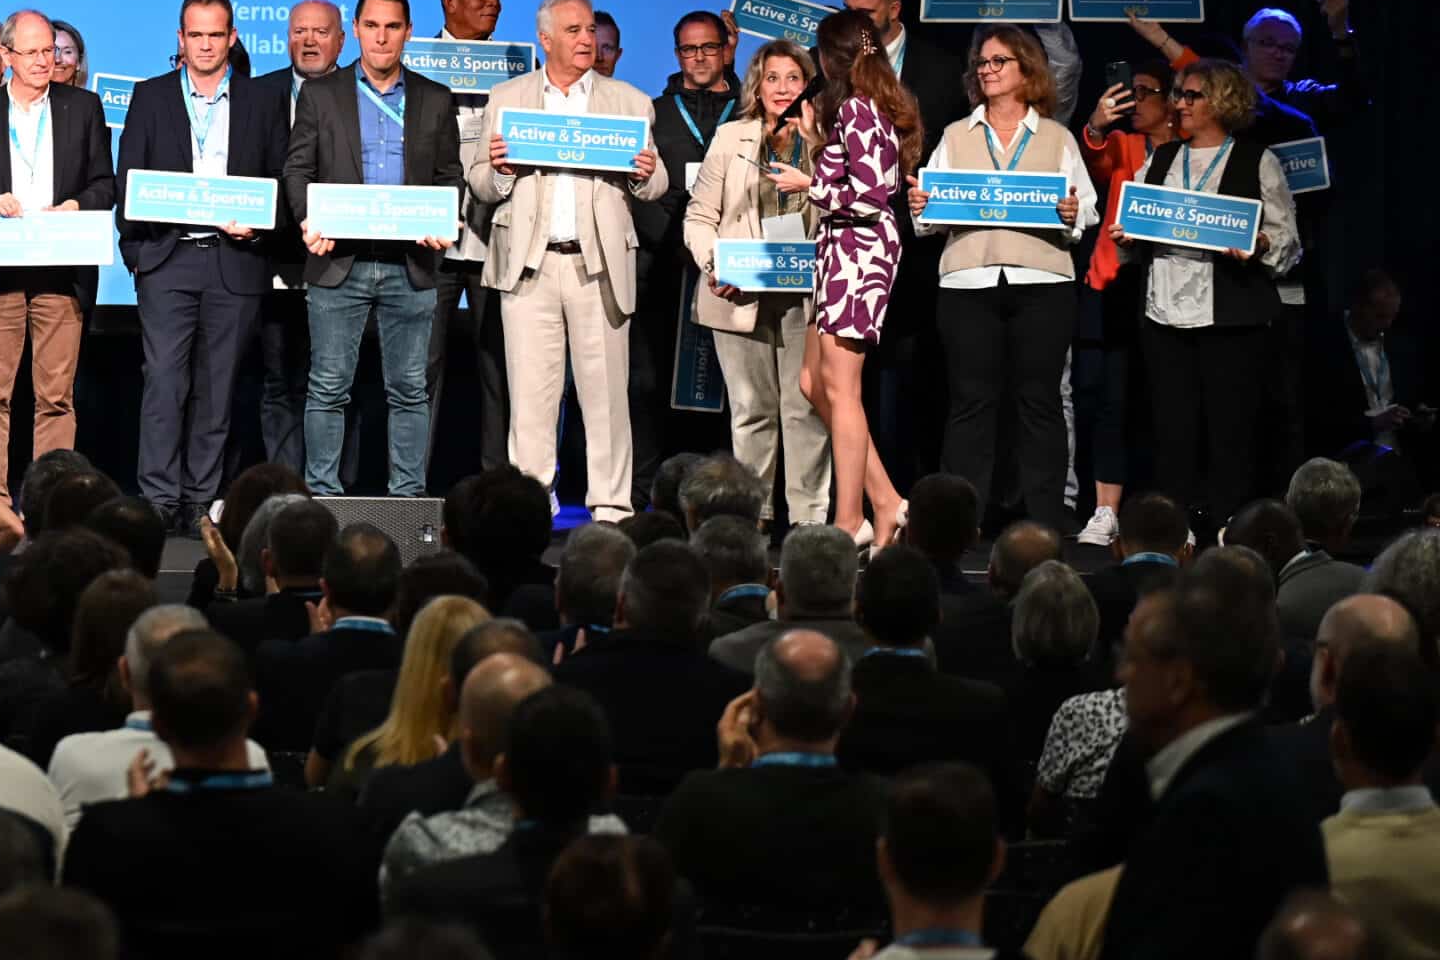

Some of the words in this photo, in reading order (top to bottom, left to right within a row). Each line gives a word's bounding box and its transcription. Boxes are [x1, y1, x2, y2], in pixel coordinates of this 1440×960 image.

[741, 0, 785, 21] Active
[789, 12, 799, 27] &
[403, 53, 447, 68] Active
[451, 56, 460, 70] &
[464, 55, 526, 74] Sportive
[103, 91, 130, 106] Acti
[508, 124, 556, 141] Active
[559, 128, 569, 142] &
[572, 130, 637, 149] Sportive
[1281, 153, 1317, 170] rtive
[928, 187, 977, 201] Active
[980, 188, 990, 201] &
[994, 187, 1058, 205] Sportive
[1128, 199, 1172, 218] Active
[1175, 205, 1186, 219] &
[1189, 208, 1249, 230] Sportive
[728, 254, 773, 269] Active
[776, 255, 787, 269] &
